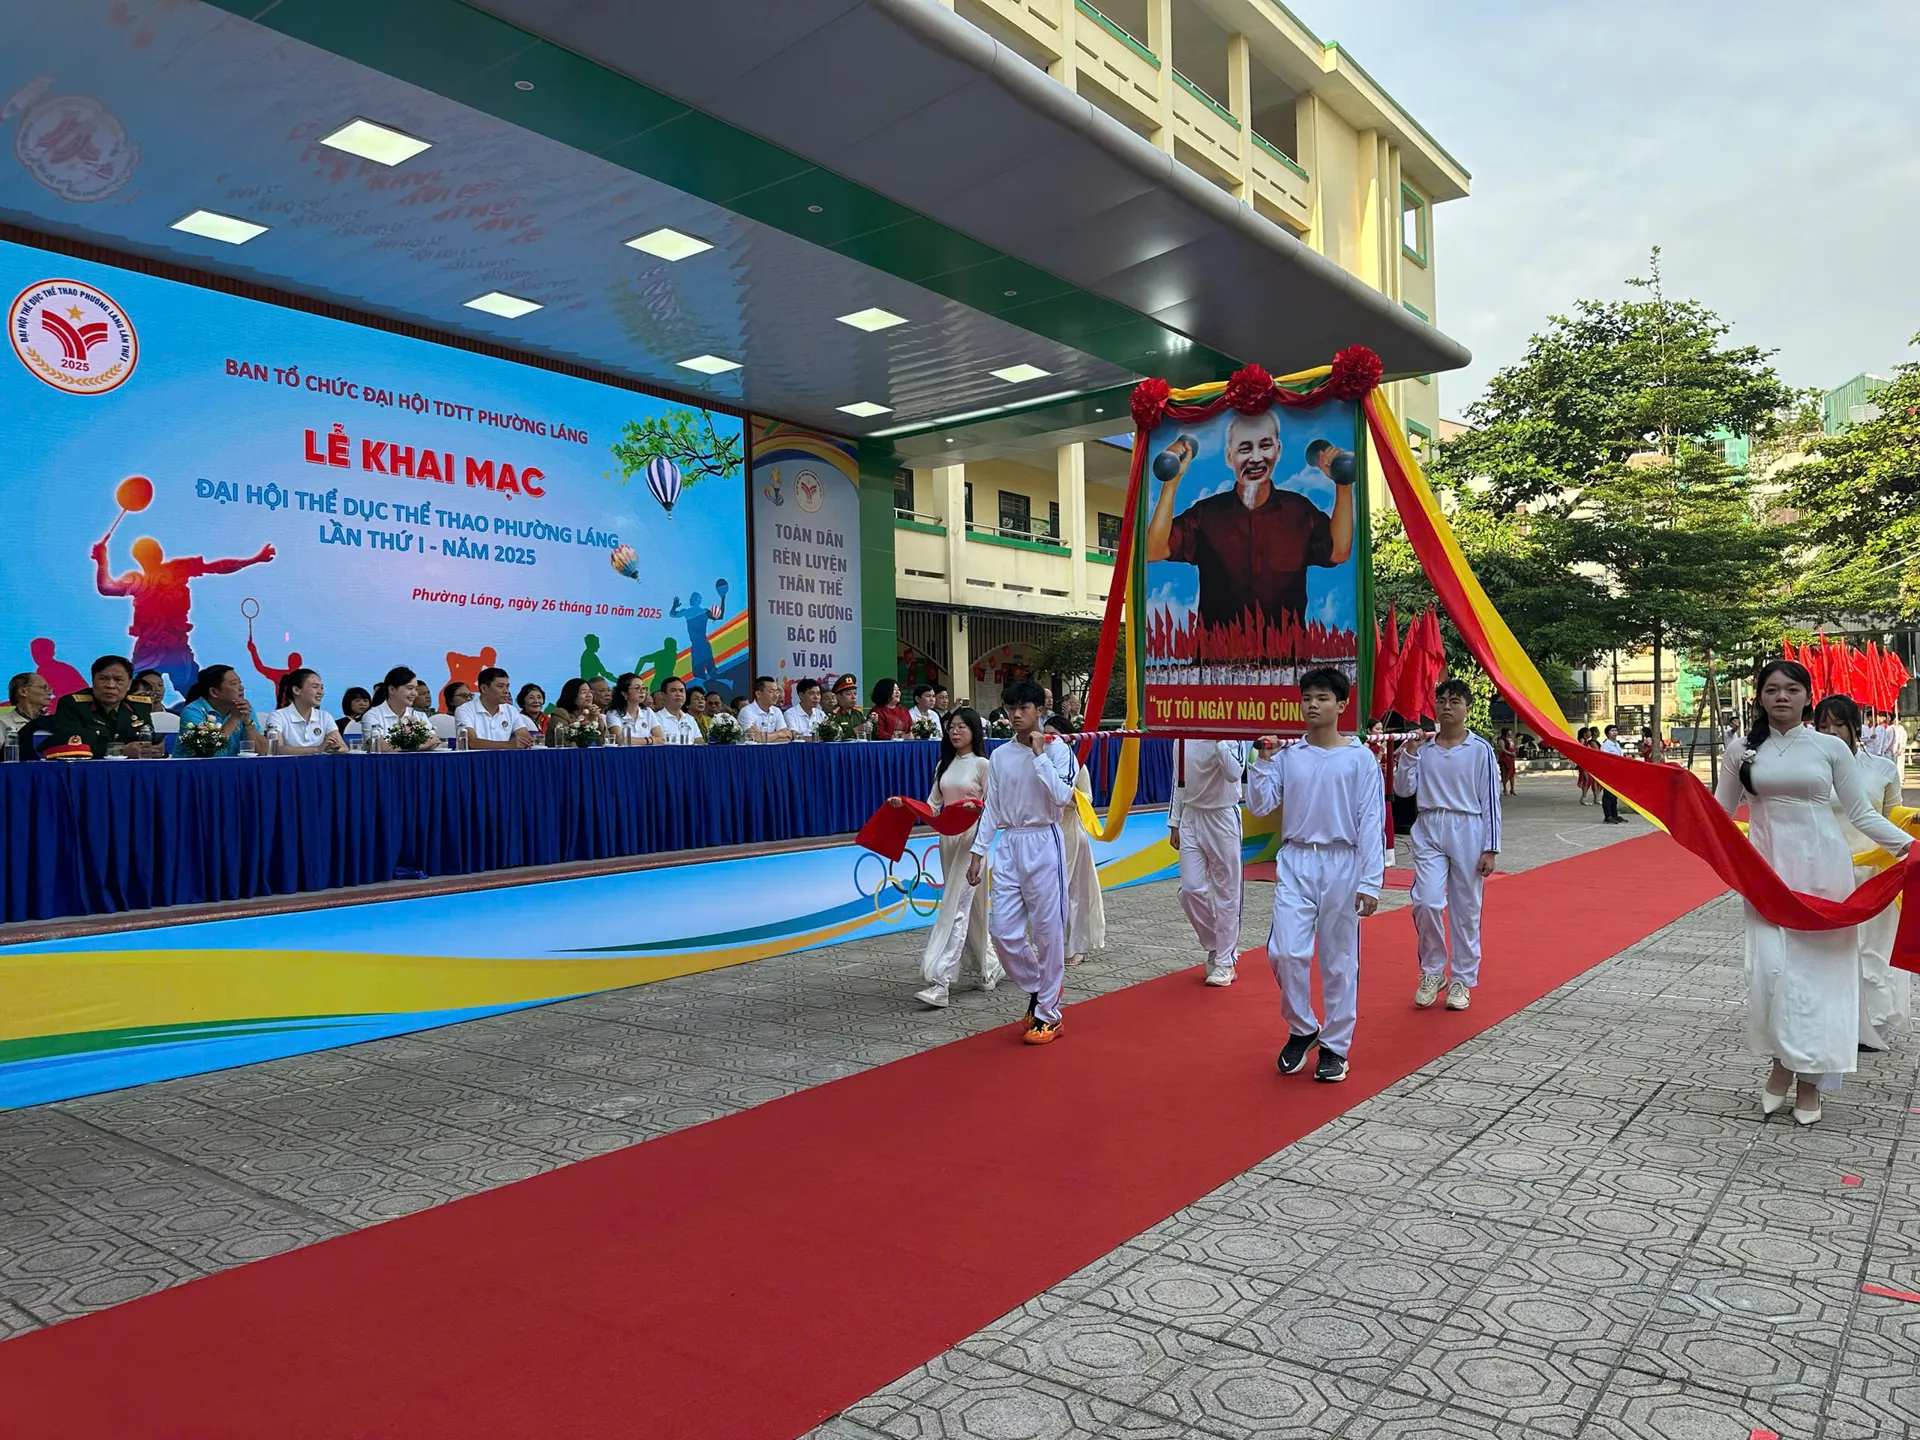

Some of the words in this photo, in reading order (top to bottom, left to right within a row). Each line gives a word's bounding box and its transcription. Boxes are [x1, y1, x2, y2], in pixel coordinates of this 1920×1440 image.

[57, 287, 78, 297] THAO
[61, 358, 90, 372] 2025
[225, 358, 269, 382] BAN
[273, 365, 301, 388] TỔ
[305, 375, 359, 400] CHỨC
[362, 386, 394, 408] ĐẠI
[398, 392, 430, 415] HỘI
[433, 400, 475, 422] TDTT
[478, 411, 547, 436] PHƯỜNG
[550, 421, 589, 445] LÁNG
[303, 422, 351, 469] LỄ
[361, 438, 455, 485] KHAI
[465, 455, 546, 500] MẠC
[195, 478, 239, 504] ĐẠI
[246, 482, 289, 511] HỘI
[294, 488, 338, 514] THỂ
[343, 496, 389, 523] DỤC
[392, 500, 432, 526] THỂ
[435, 508, 490, 533] THAO
[493, 516, 573, 544] PHƯỜNG
[576, 527, 620, 550] LÁNG
[319, 518, 362, 547] LẦN
[367, 530, 414, 552] THỨ
[418, 536, 426, 554] I
[442, 537, 490, 561] NĂM
[494, 545, 537, 566] 2025
[775, 523, 813, 545] TOÀN
[816, 529, 845, 549] DÂN
[772, 547, 802, 567] RÈN
[805, 552, 848, 575] LUYỆN
[778, 574, 816, 594] THÂN
[818, 576, 844, 597] THỂ
[412, 588, 467, 607] Phường
[470, 592, 505, 610] Láng,
[508, 597, 539, 613] ngày
[541, 598, 556, 611] 26
[559, 599, 593, 616] tháng
[595, 602, 609, 615] 10
[611, 604, 635, 617] năm
[637, 606, 662, 619] 2025
[767, 599, 804, 618] THEO
[807, 603, 854, 622] GƯƠNG
[787, 625, 816, 643] BÁC
[819, 624, 838, 645] HỒ
[792, 649, 807, 668] VĨ
[809, 652, 833, 672] ĐẠI
[1174, 696, 1195, 720] TÔI
[1198, 697, 1233, 721] NGÀY
[1237, 696, 1266, 722] NÀO
